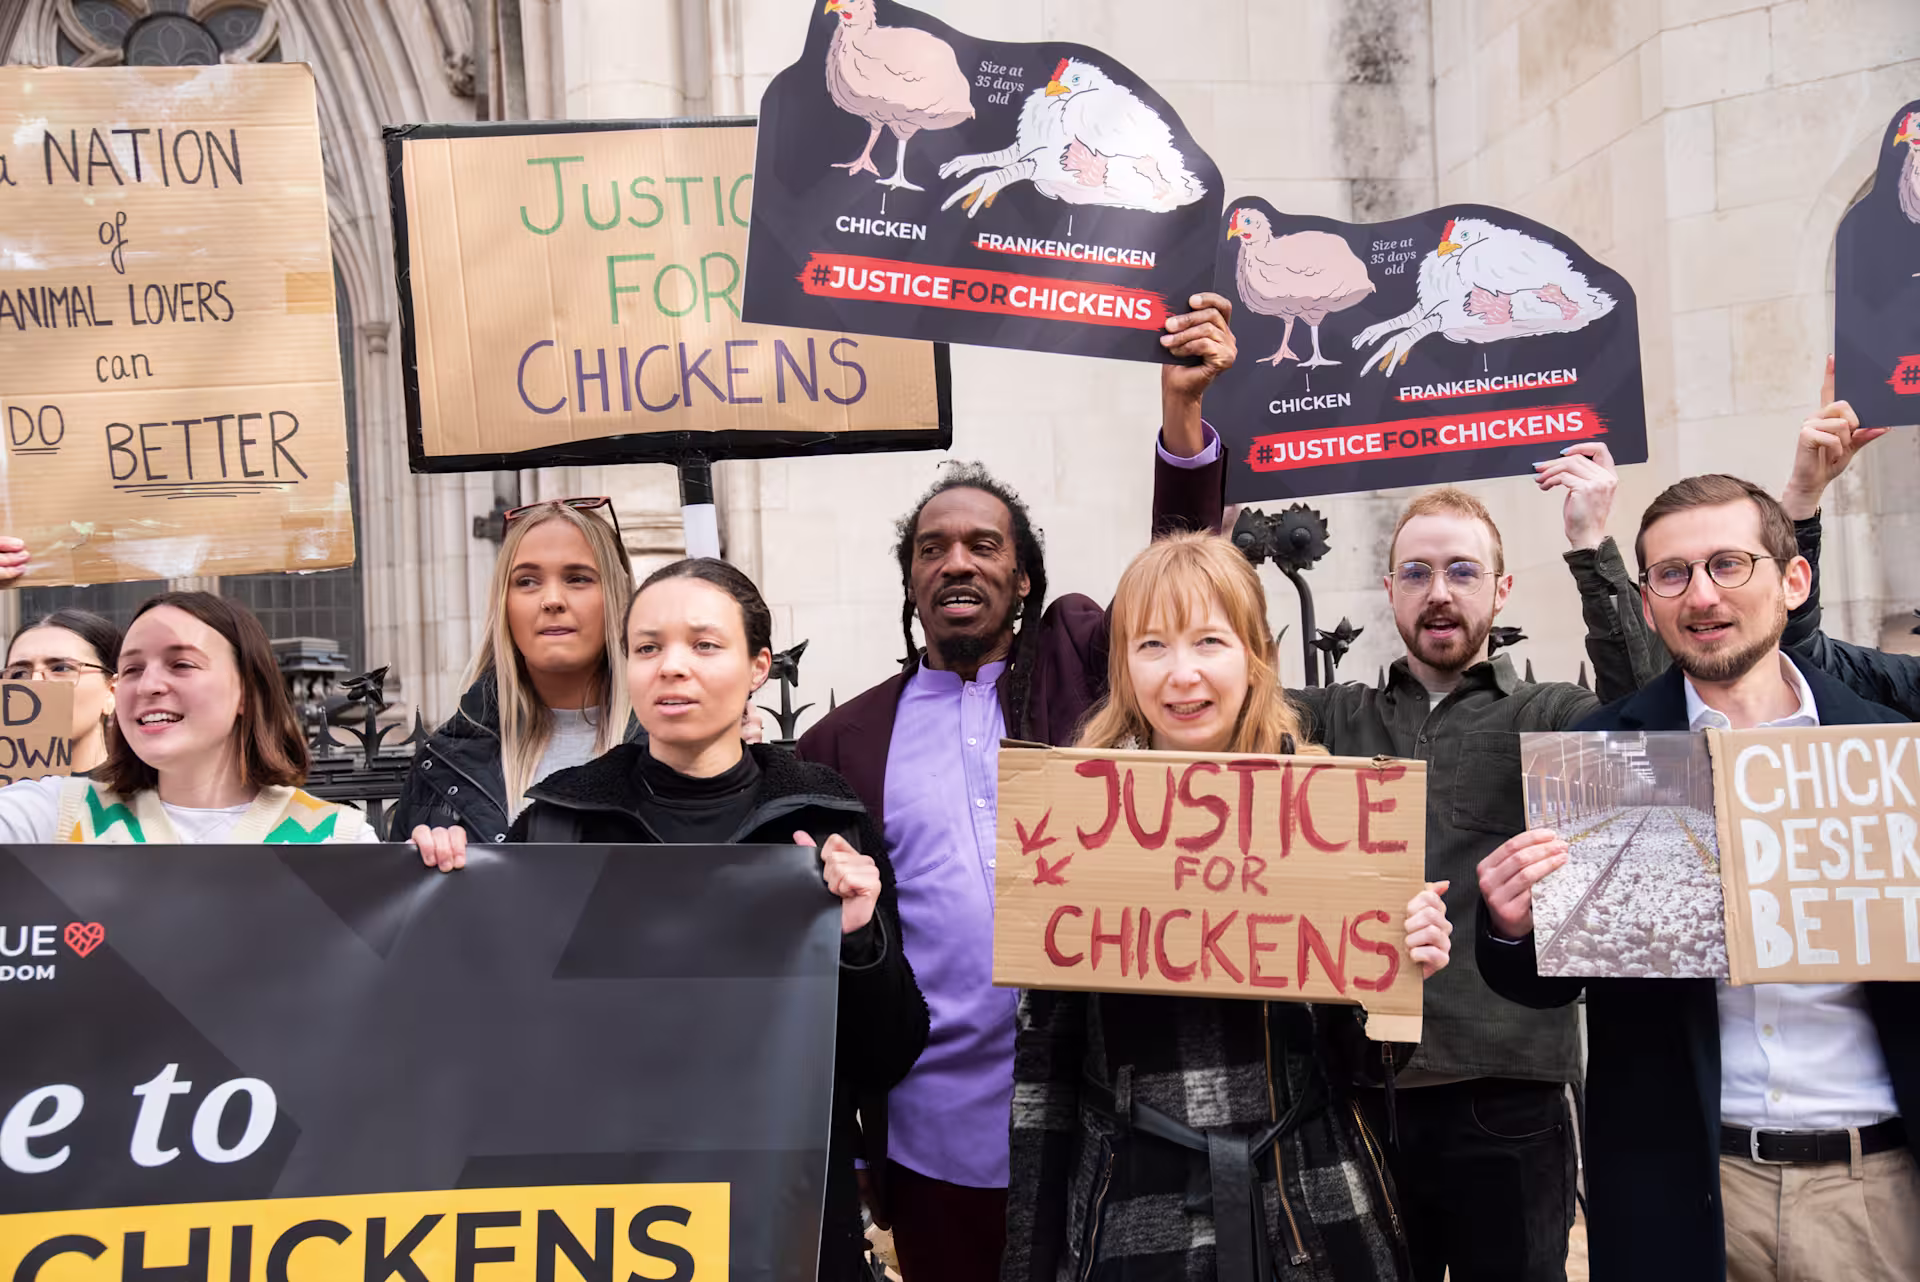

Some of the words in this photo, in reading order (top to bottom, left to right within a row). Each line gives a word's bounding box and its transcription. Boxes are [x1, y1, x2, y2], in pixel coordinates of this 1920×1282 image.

[975, 75, 991, 88] 35
[993, 77, 1025, 94] days
[979, 60, 1007, 75] Size
[1009, 66, 1023, 77] at
[988, 92, 1010, 105] old
[44, 128, 243, 188] NATION
[99, 211, 128, 274] of
[835, 215, 927, 241] CHICKEN
[977, 232, 1156, 268] FRANKENCHICKEN
[1371, 240, 1398, 252] Size
[1400, 237, 1414, 248] at
[1370, 253, 1385, 265] 35
[1387, 251, 1417, 264] days
[1384, 262, 1405, 276] old
[0, 286, 113, 331] ANIMAL
[128, 279, 235, 326] LOVERS
[606, 252, 742, 325] FOR
[811, 263, 1153, 322] #JUSTICEFORCHICKENS
[96, 353, 153, 383] can
[517, 337, 868, 415] CHICKENS
[1399, 368, 1579, 401] FRANKENCHICKEN
[1268, 392, 1352, 416] CHICKEN
[8, 404, 65, 446] DO
[106, 410, 309, 482] BETTER
[1255, 410, 1585, 465] #JUSTICEFORCHICKENS
[2, 683, 42, 727] D
[1733, 737, 1920, 814] CHICK
[1074, 758, 1409, 859] JUSTICE
[1740, 812, 1920, 885] DESER
[1174, 855, 1269, 896] FOR
[0, 925, 58, 957] UE
[1044, 904, 1401, 995] CHICKENS
[0, 1084, 85, 1174] e
[130, 1063, 278, 1167] to
